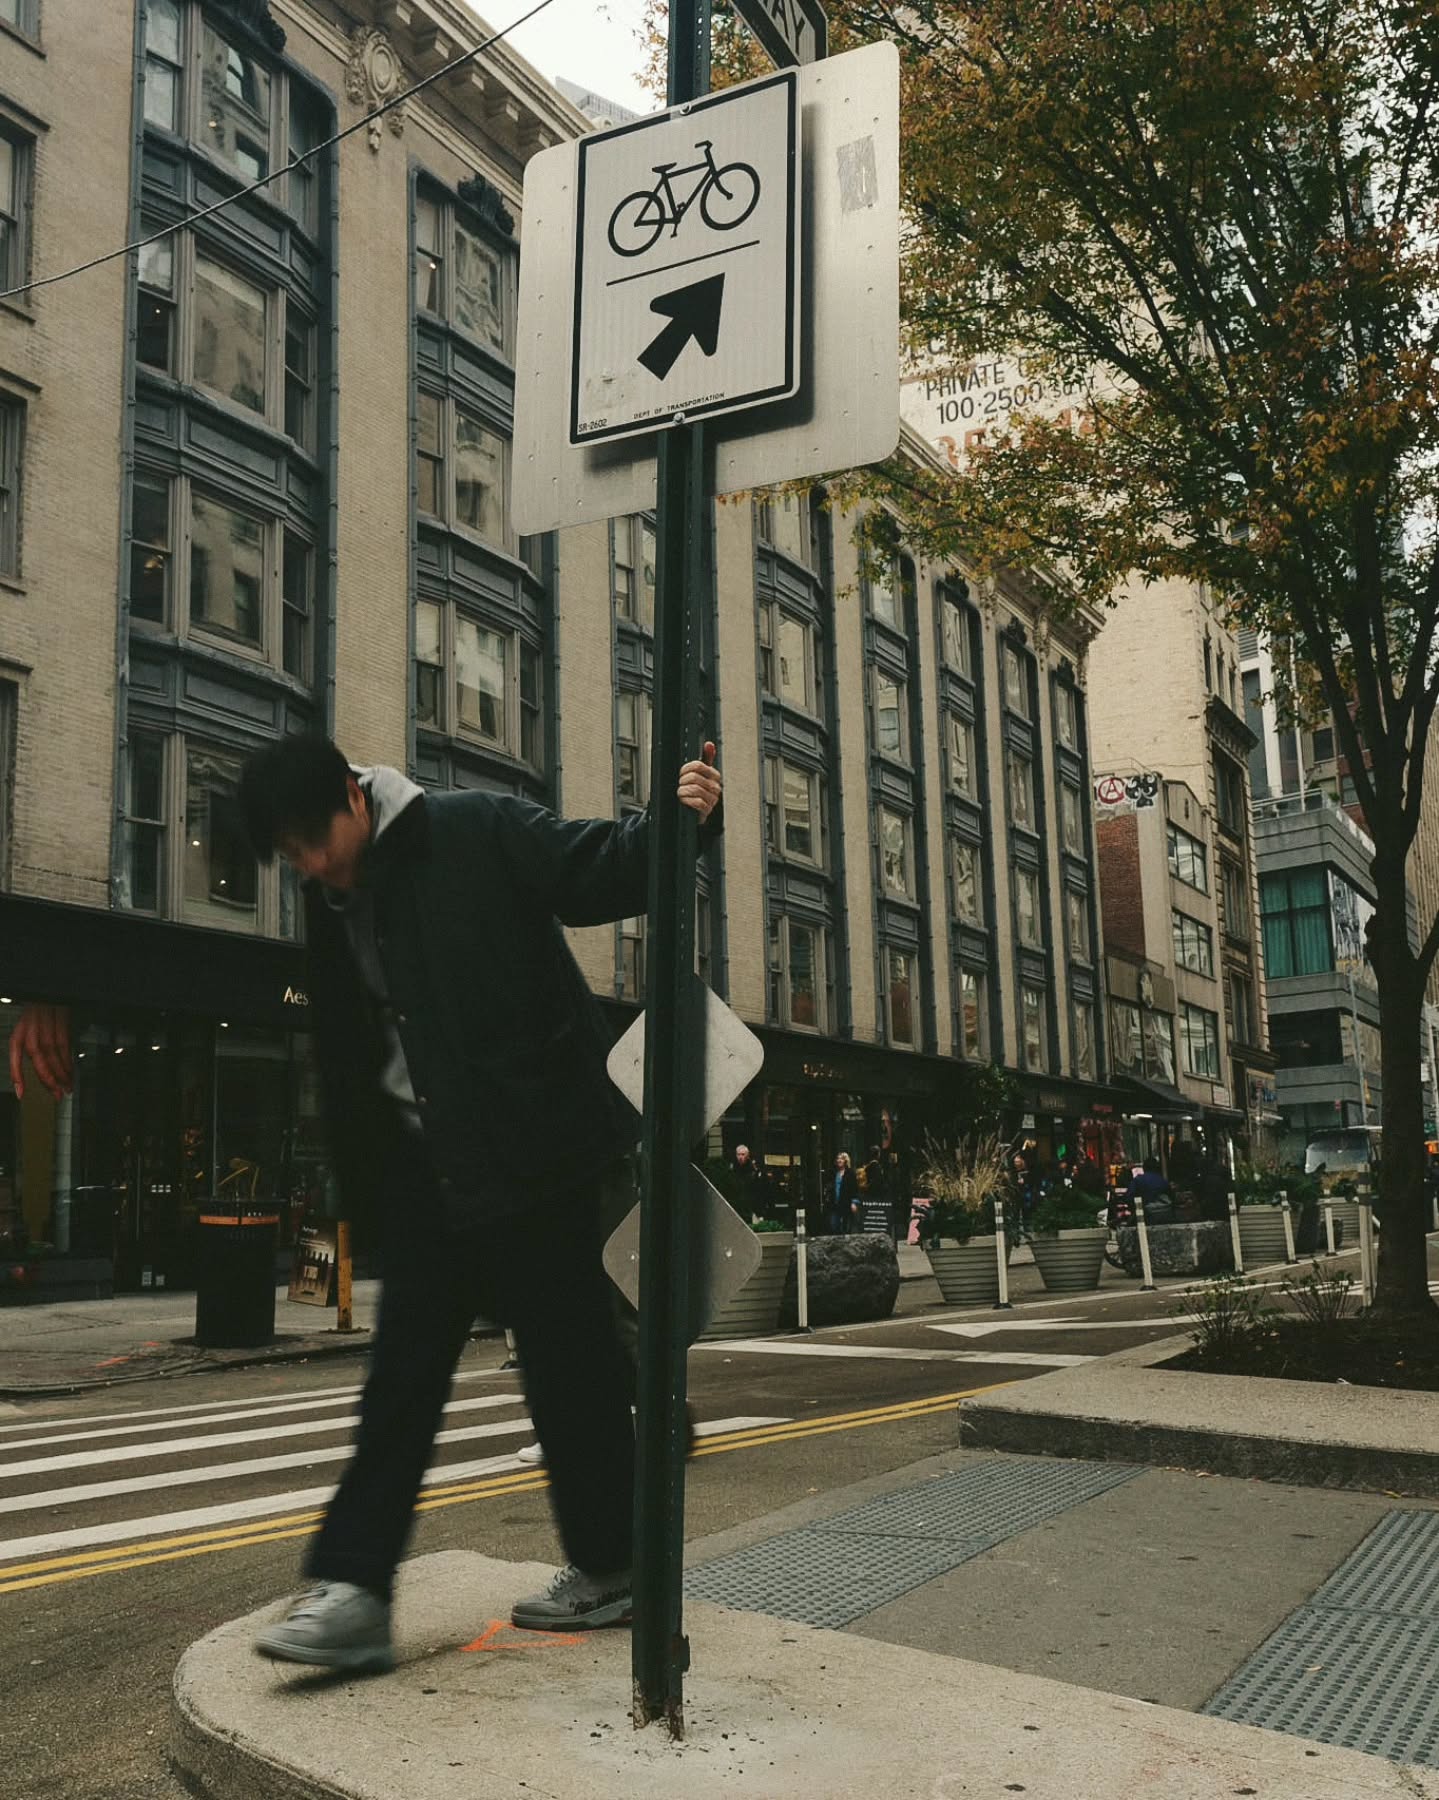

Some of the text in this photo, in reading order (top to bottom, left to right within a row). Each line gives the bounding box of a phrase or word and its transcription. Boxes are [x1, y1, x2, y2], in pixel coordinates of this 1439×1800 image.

[927, 361, 1004, 400] PRIVATE
[634, 410, 650, 420] DEPT
[667, 392, 725, 412] TRANSPORTATION
